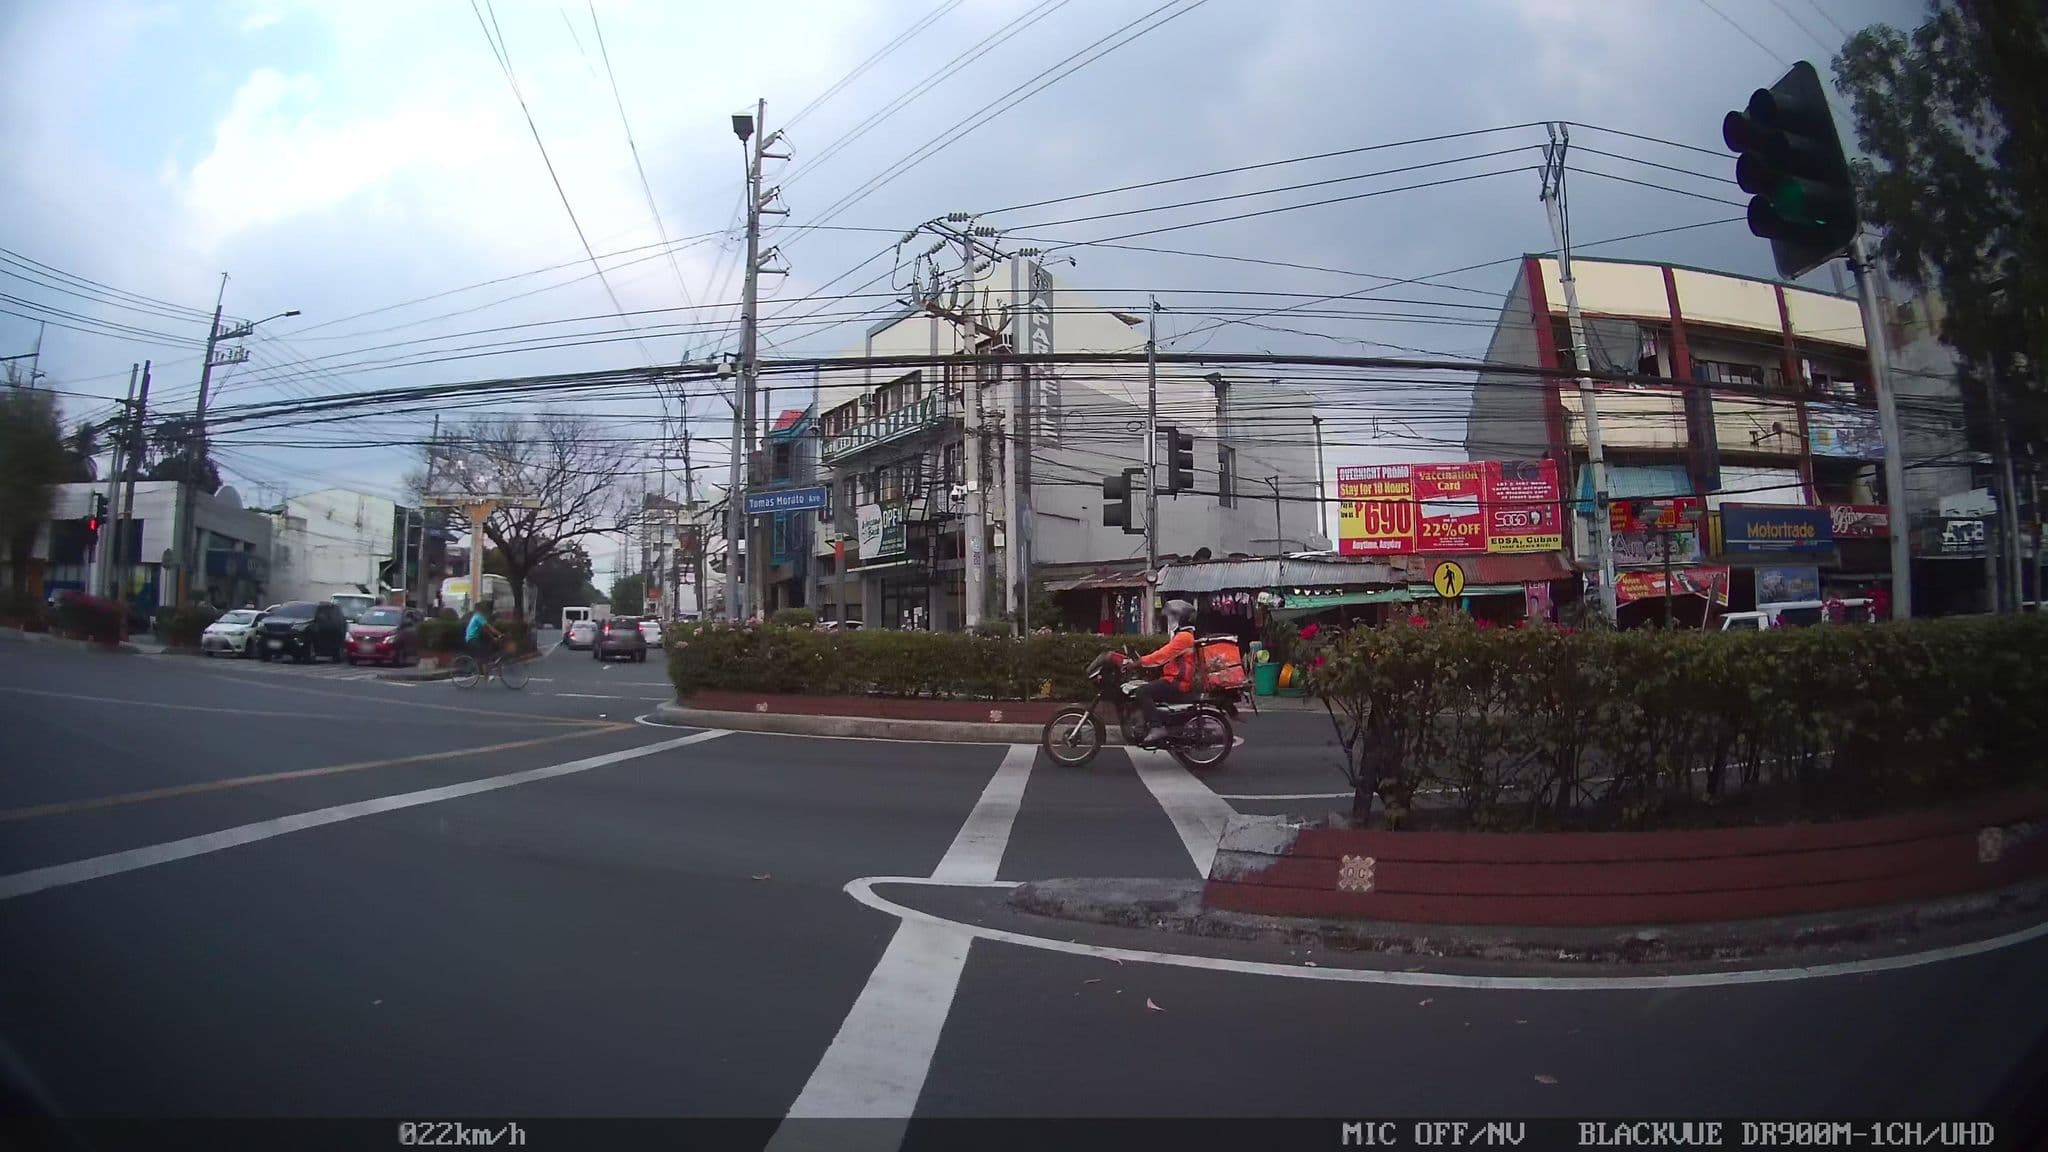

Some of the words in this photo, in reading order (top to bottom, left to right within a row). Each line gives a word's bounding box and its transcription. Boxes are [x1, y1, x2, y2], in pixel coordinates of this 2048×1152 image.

[1340, 467, 1381, 480] OVERNIGHT
[1382, 465, 1409, 479] PROMO
[1419, 470, 1479, 481] Vaccination
[1341, 483, 1359, 497] Stay
[1360, 483, 1372, 495] for
[1373, 482, 1383, 495] 10
[1384, 481, 1410, 494] Hours
[1437, 481, 1461, 491] Card
[749, 498, 775, 509] Tomas
[776, 494, 804, 505] Morato
[1495, 510, 1529, 527] SOGO
[1747, 521, 1816, 538] Motortrade
[1491, 537, 1523, 545] EDSA,
